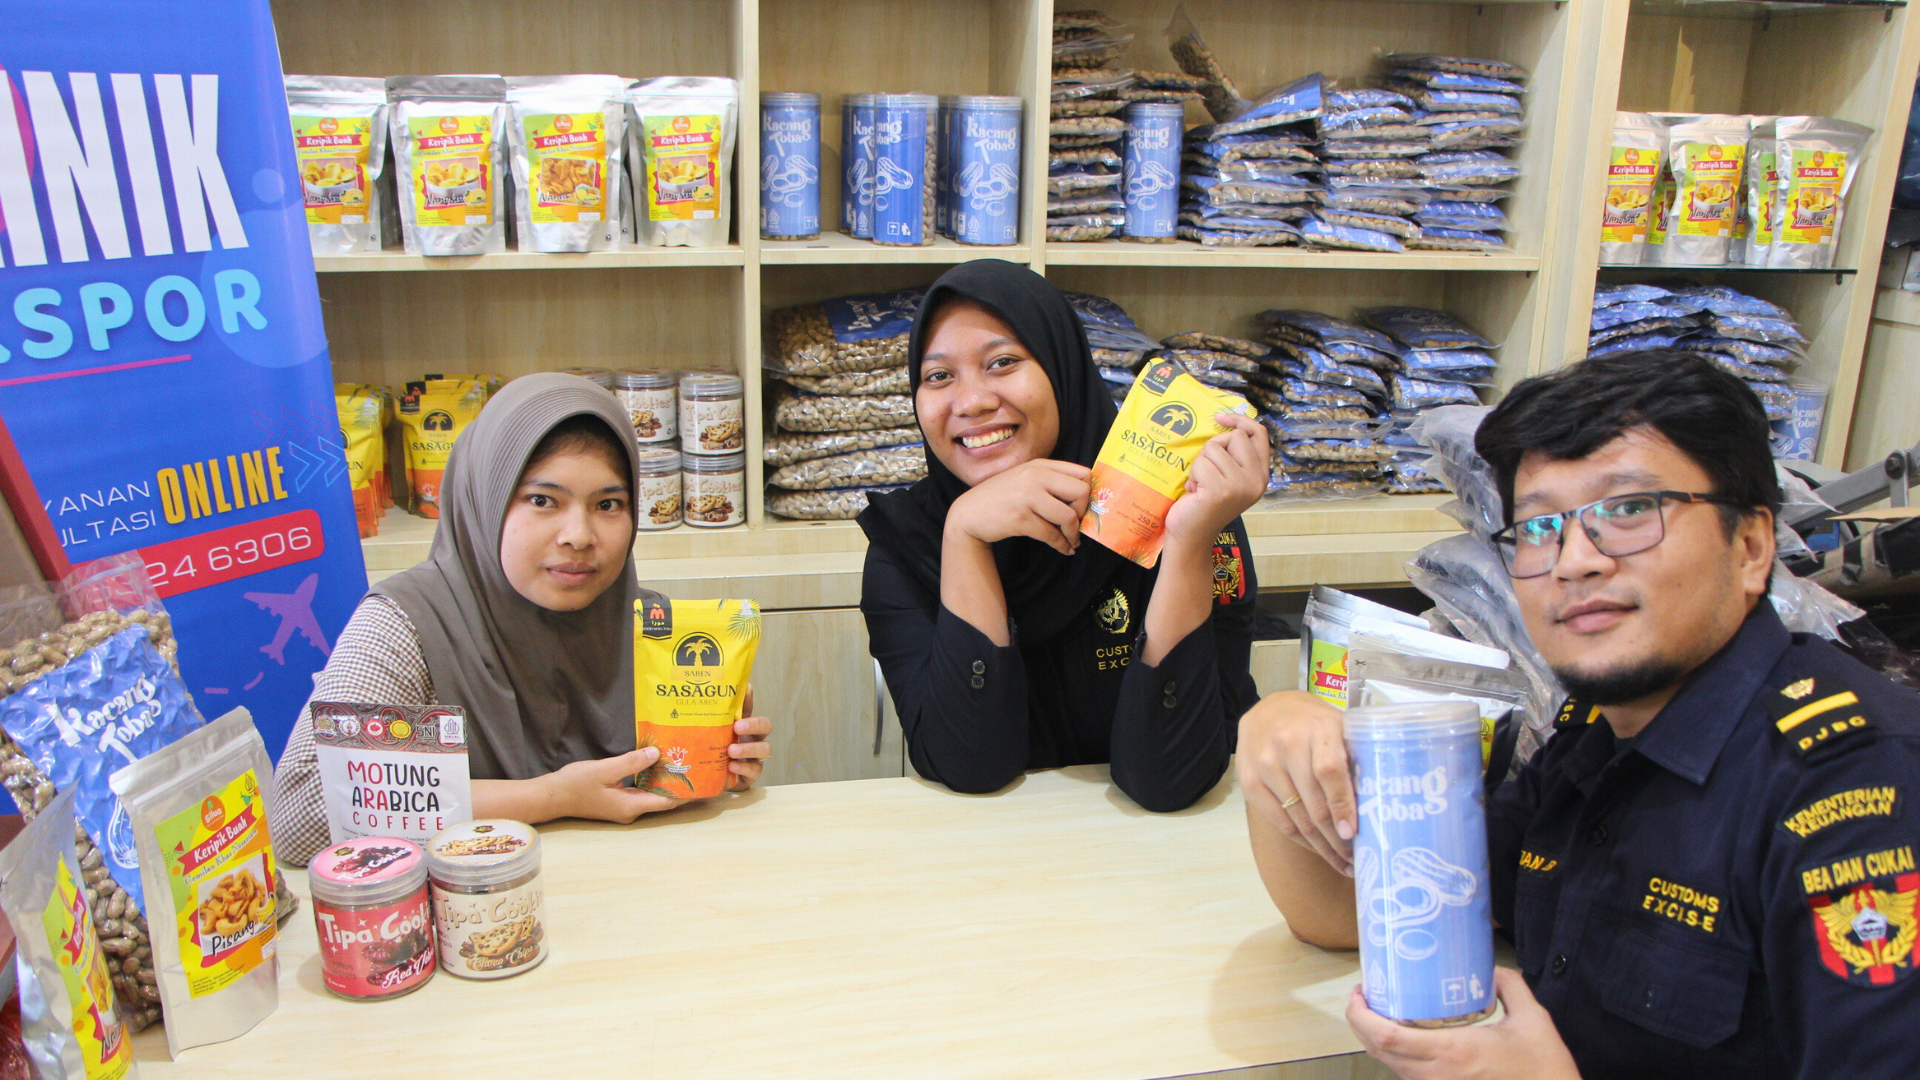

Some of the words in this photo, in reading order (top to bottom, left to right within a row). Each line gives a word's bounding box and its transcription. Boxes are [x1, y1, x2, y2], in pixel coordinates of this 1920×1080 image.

[763, 110, 811, 141] Kacang
[853, 114, 875, 136] Kac
[967, 116, 1017, 149] Kacang
[1128, 127, 1169, 148] acang
[306, 134, 333, 148] Keripik
[333, 134, 352, 146] Buah
[428, 137, 454, 148] Keripik
[455, 134, 474, 145] Buah
[543, 136, 568, 146] Keripik
[569, 133, 587, 143] Buah
[660, 135, 686, 147] Keripik
[686, 133, 704, 143] Buah
[769, 131, 802, 157] Toba
[974, 138, 1008, 164] Toba
[1129, 137, 1159, 162] Toba
[0, 70, 249, 268] INIK
[0, 268, 268, 364] SPOR
[1150, 425, 1173, 441] SAREN
[1121, 429, 1190, 472] SASAGUN
[156, 446, 287, 525] ONLINE
[1138, 514, 1151, 526] 250
[146, 555, 197, 587] 24
[208, 527, 312, 572] 6306
[684, 670, 711, 678] SAREN
[1098, 656, 1130, 671] EXC
[656, 684, 739, 698] SASAGUN
[1325, 674, 1348, 692] Kerip
[47, 671, 162, 747] Kacang
[98, 714, 155, 764] Toba
[416, 725, 436, 738] SNI
[347, 760, 440, 787] MOTUNG
[352, 786, 440, 812] ARABICA
[1784, 786, 1896, 833] KEMENTERIAN
[353, 811, 444, 831] COFFEE
[1358, 796, 1425, 851] Toba
[1795, 801, 1893, 838] KEUANGAN
[194, 832, 228, 863] Keripik
[225, 815, 248, 840] Buah
[184, 862, 215, 885] Cemilan
[1802, 866, 1834, 894] BEA
[1831, 856, 1866, 886] DAN
[1865, 845, 1916, 877] CUKAI
[1649, 877, 1720, 913] CUSTOMS
[436, 894, 482, 929] Tipa
[488, 888, 543, 923] Cooki
[212, 920, 255, 956] Pisang
[318, 911, 374, 950] Tipa
[380, 900, 431, 941] Cooki
[473, 957, 504, 971] Choco
[505, 945, 534, 965] Chips
[382, 965, 413, 989] Red
